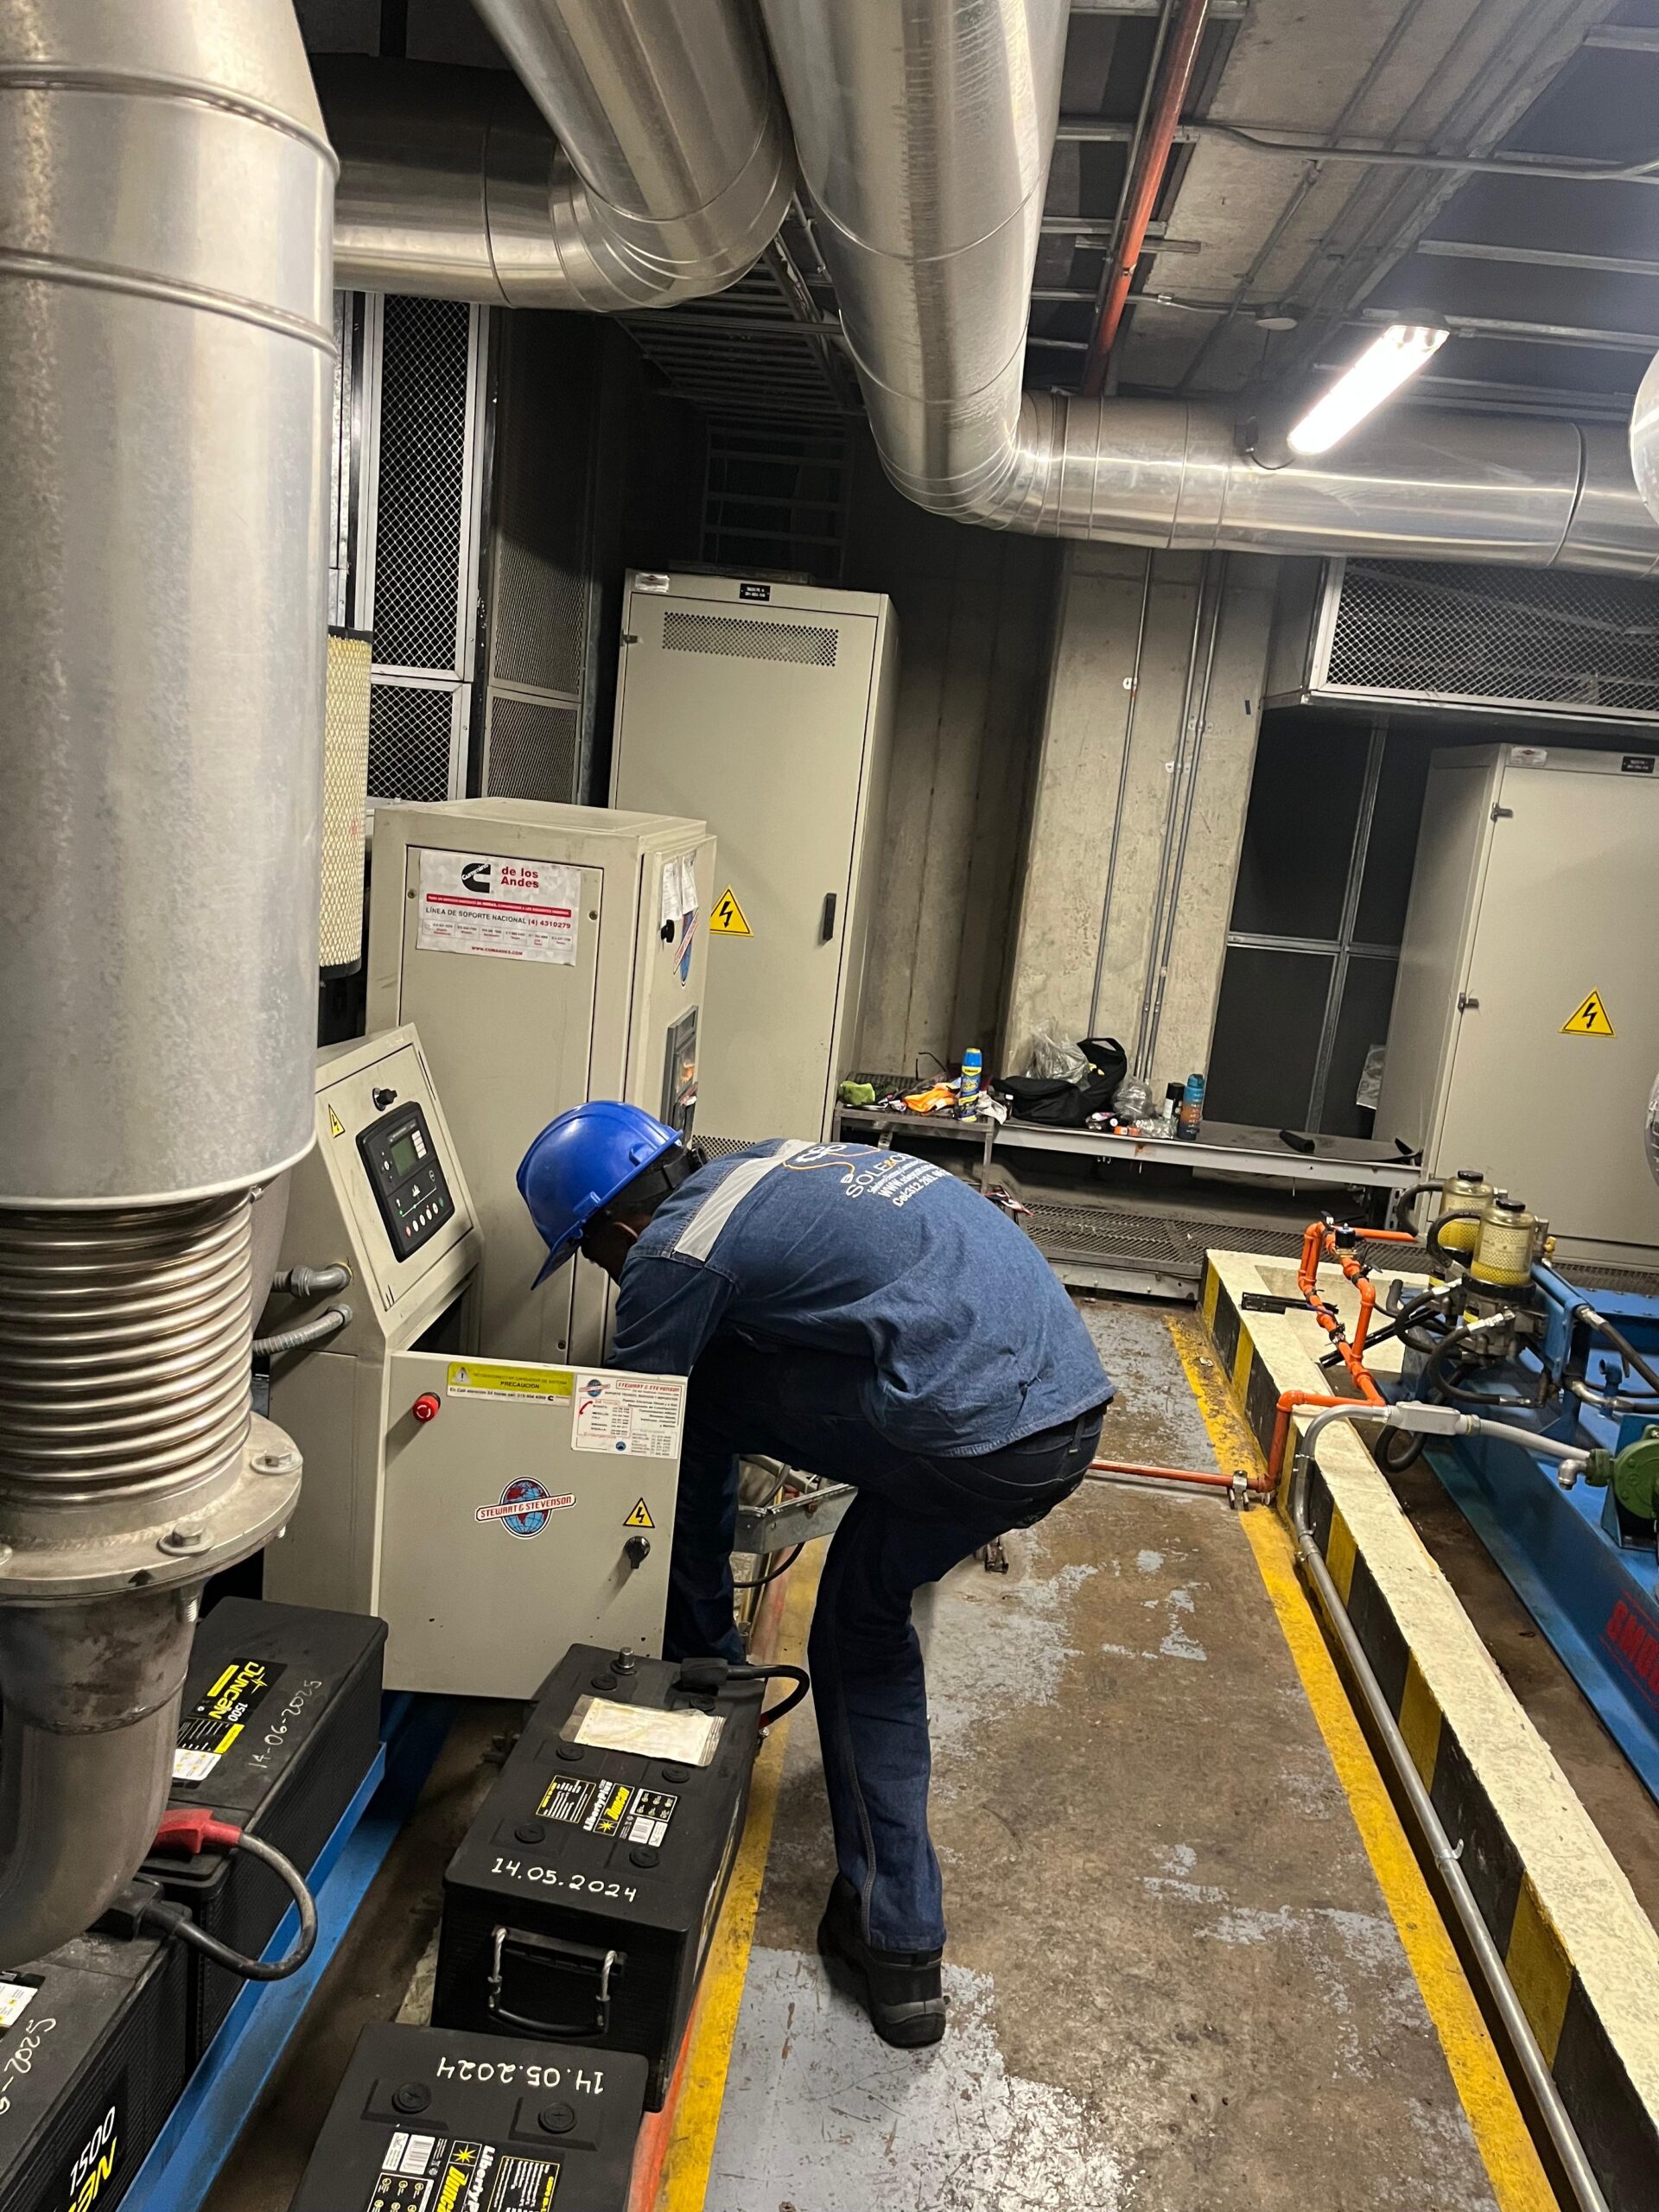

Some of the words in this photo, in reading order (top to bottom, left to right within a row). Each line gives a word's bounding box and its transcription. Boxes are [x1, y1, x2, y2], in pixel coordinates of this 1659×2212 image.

[500, 876, 539, 888] Andes
[501, 866, 517, 876] de
[521, 868, 538, 879] los
[425, 906, 446, 915] LÍNEA
[458, 911, 491, 920] SOPORTE
[492, 915, 526, 924] NACIONAL
[480, 1505, 517, 1518] STEWART
[525, 1496, 572, 1511] STEVENSON
[227, 1701, 249, 1722] 1500
[604, 1786, 630, 1821] Duncan
[491, 1858, 637, 1903] 14.05.2024
[436, 2056, 604, 2094] 14.05.2024
[69, 2106, 116, 2196] 1500
